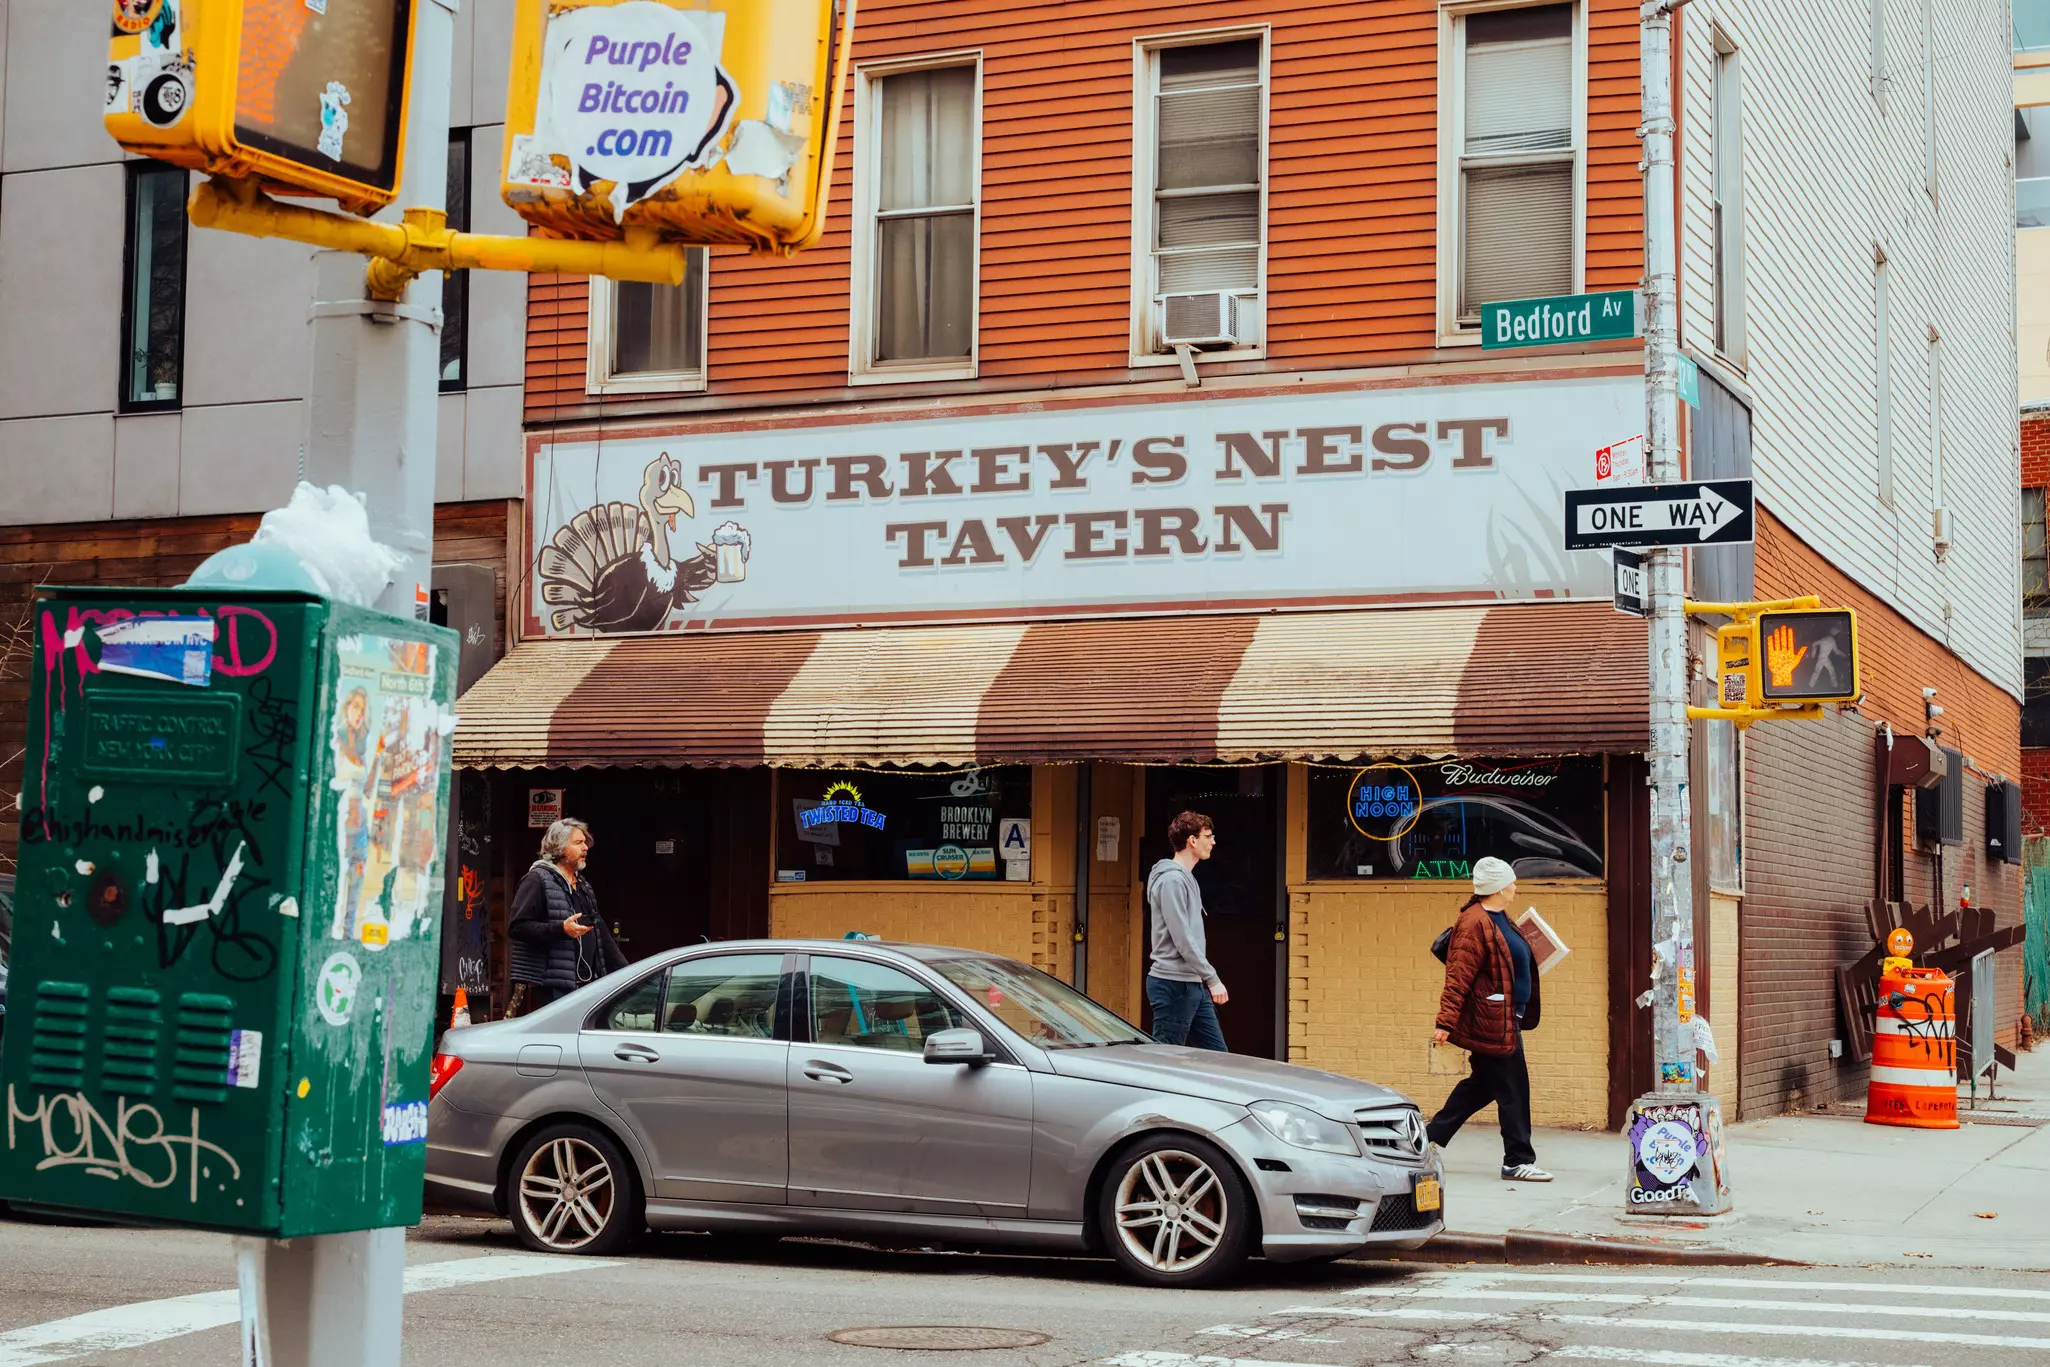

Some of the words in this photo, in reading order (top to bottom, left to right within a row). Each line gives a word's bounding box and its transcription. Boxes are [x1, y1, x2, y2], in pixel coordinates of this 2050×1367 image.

[584, 32, 692, 72] Purple
[578, 81, 690, 114] Bitcoin
[586, 128, 673, 156] .com
[1496, 301, 1591, 342] Bedford
[1602, 297, 1622, 317] Av
[699, 433, 1189, 510] TURKEY'S
[1214, 416, 1510, 481] NEST
[1591, 505, 1643, 530] ONE
[1668, 501, 1724, 526] WAY
[885, 502, 1290, 569] TAVERN
[1622, 568, 1640, 595] ONE
[91, 712, 153, 732] TRAFFIC
[157, 715, 227, 736] CONTROL
[1440, 763, 1558, 786] Budweiser
[1360, 785, 1409, 802] HIGH
[799, 806, 860, 829] TWISTED
[860, 807, 887, 831] TEA
[941, 806, 993, 823] BROOKLYN
[1355, 802, 1414, 818] NOON
[942, 823, 990, 840] BREWERY
[1004, 823, 1026, 848] A
[1415, 860, 1470, 879] ATM
